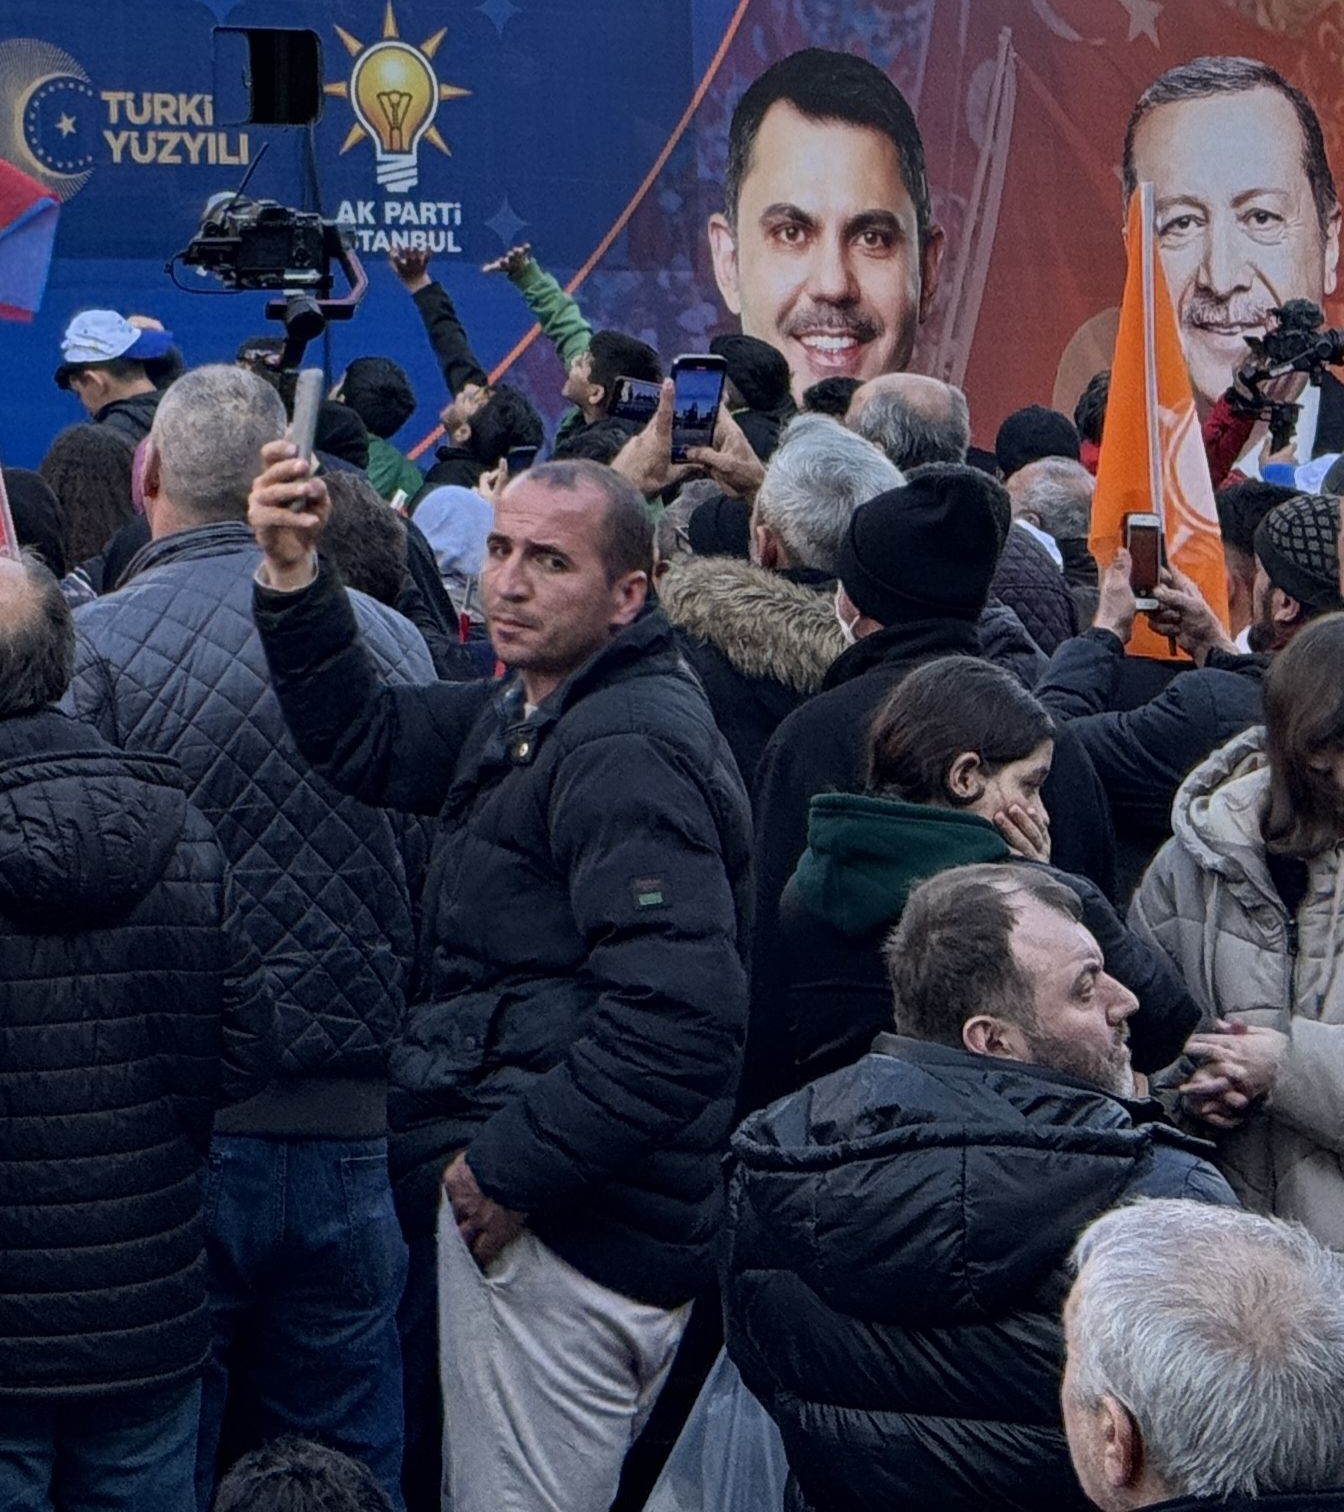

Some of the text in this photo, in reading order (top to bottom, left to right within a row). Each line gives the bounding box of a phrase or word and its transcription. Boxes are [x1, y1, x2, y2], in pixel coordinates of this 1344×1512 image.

[100, 91, 214, 126] TÜRKİ
[102, 129, 250, 165] YÜZYILI
[336, 199, 462, 226] AK PARTİ
[355, 229, 462, 253] TANBUL
